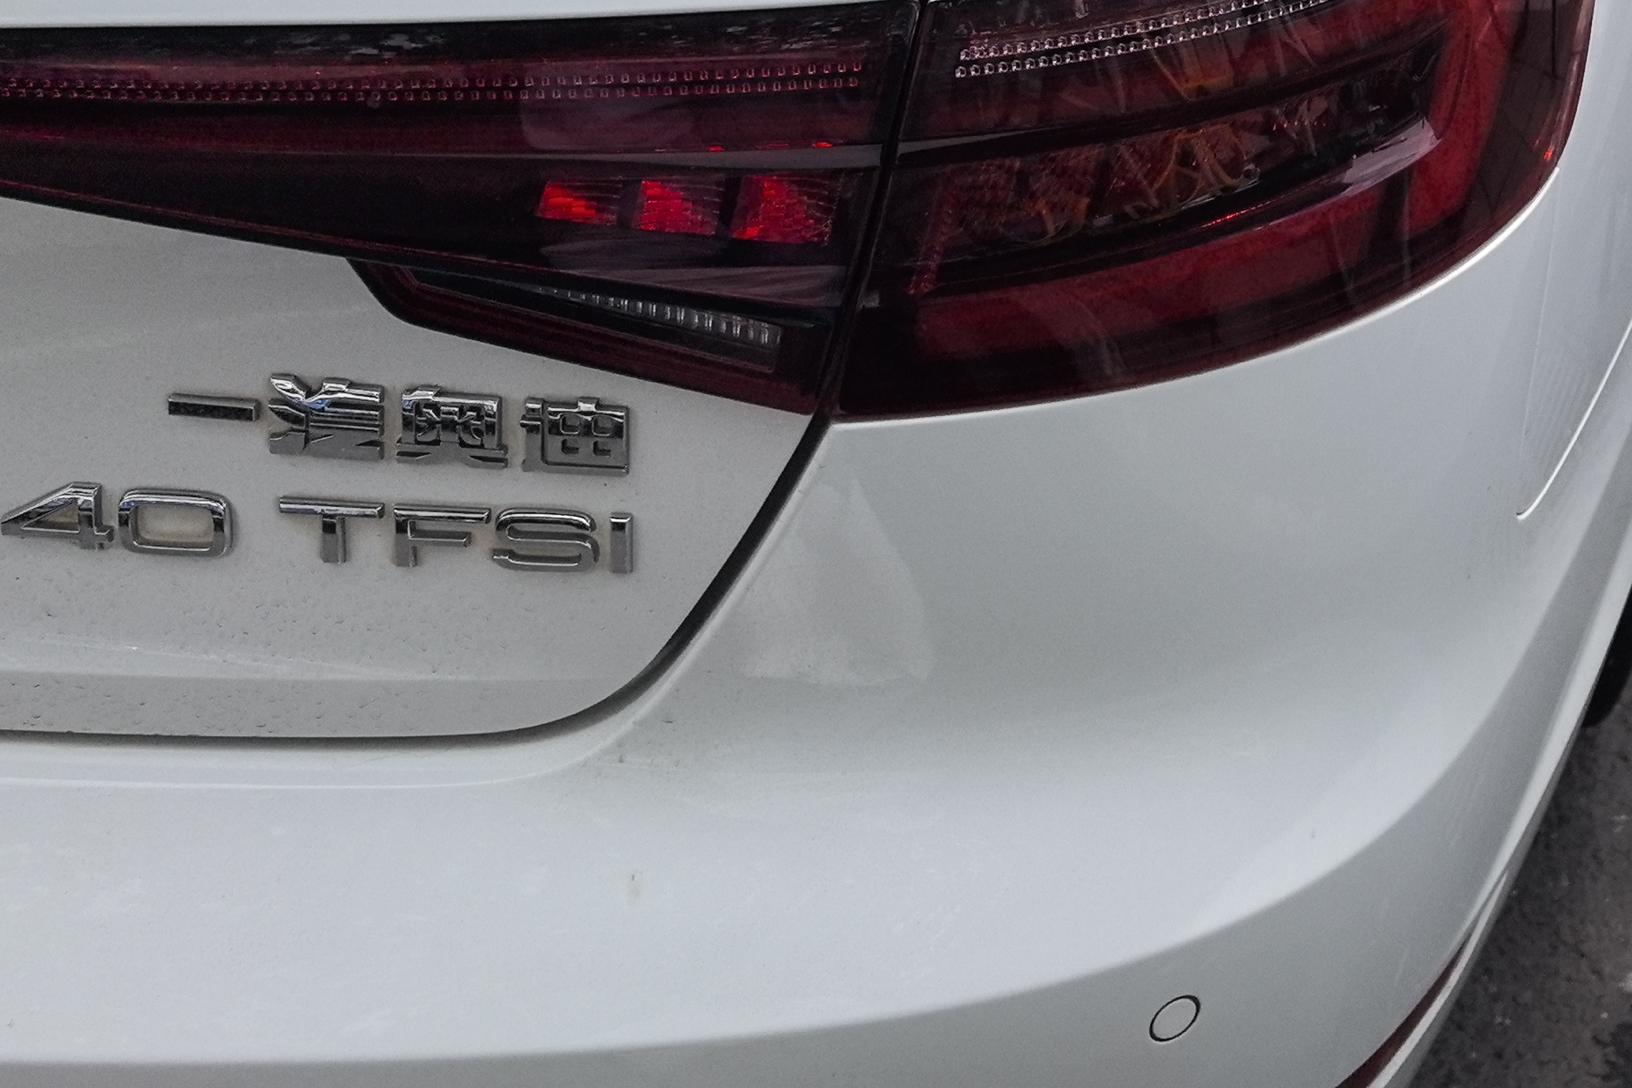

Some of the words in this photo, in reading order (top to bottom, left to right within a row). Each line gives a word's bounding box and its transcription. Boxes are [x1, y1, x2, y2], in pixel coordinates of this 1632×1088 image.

[167, 372, 630, 475] 一汽奥迪
[0, 481, 233, 558] 40
[279, 494, 634, 574] TFSI
